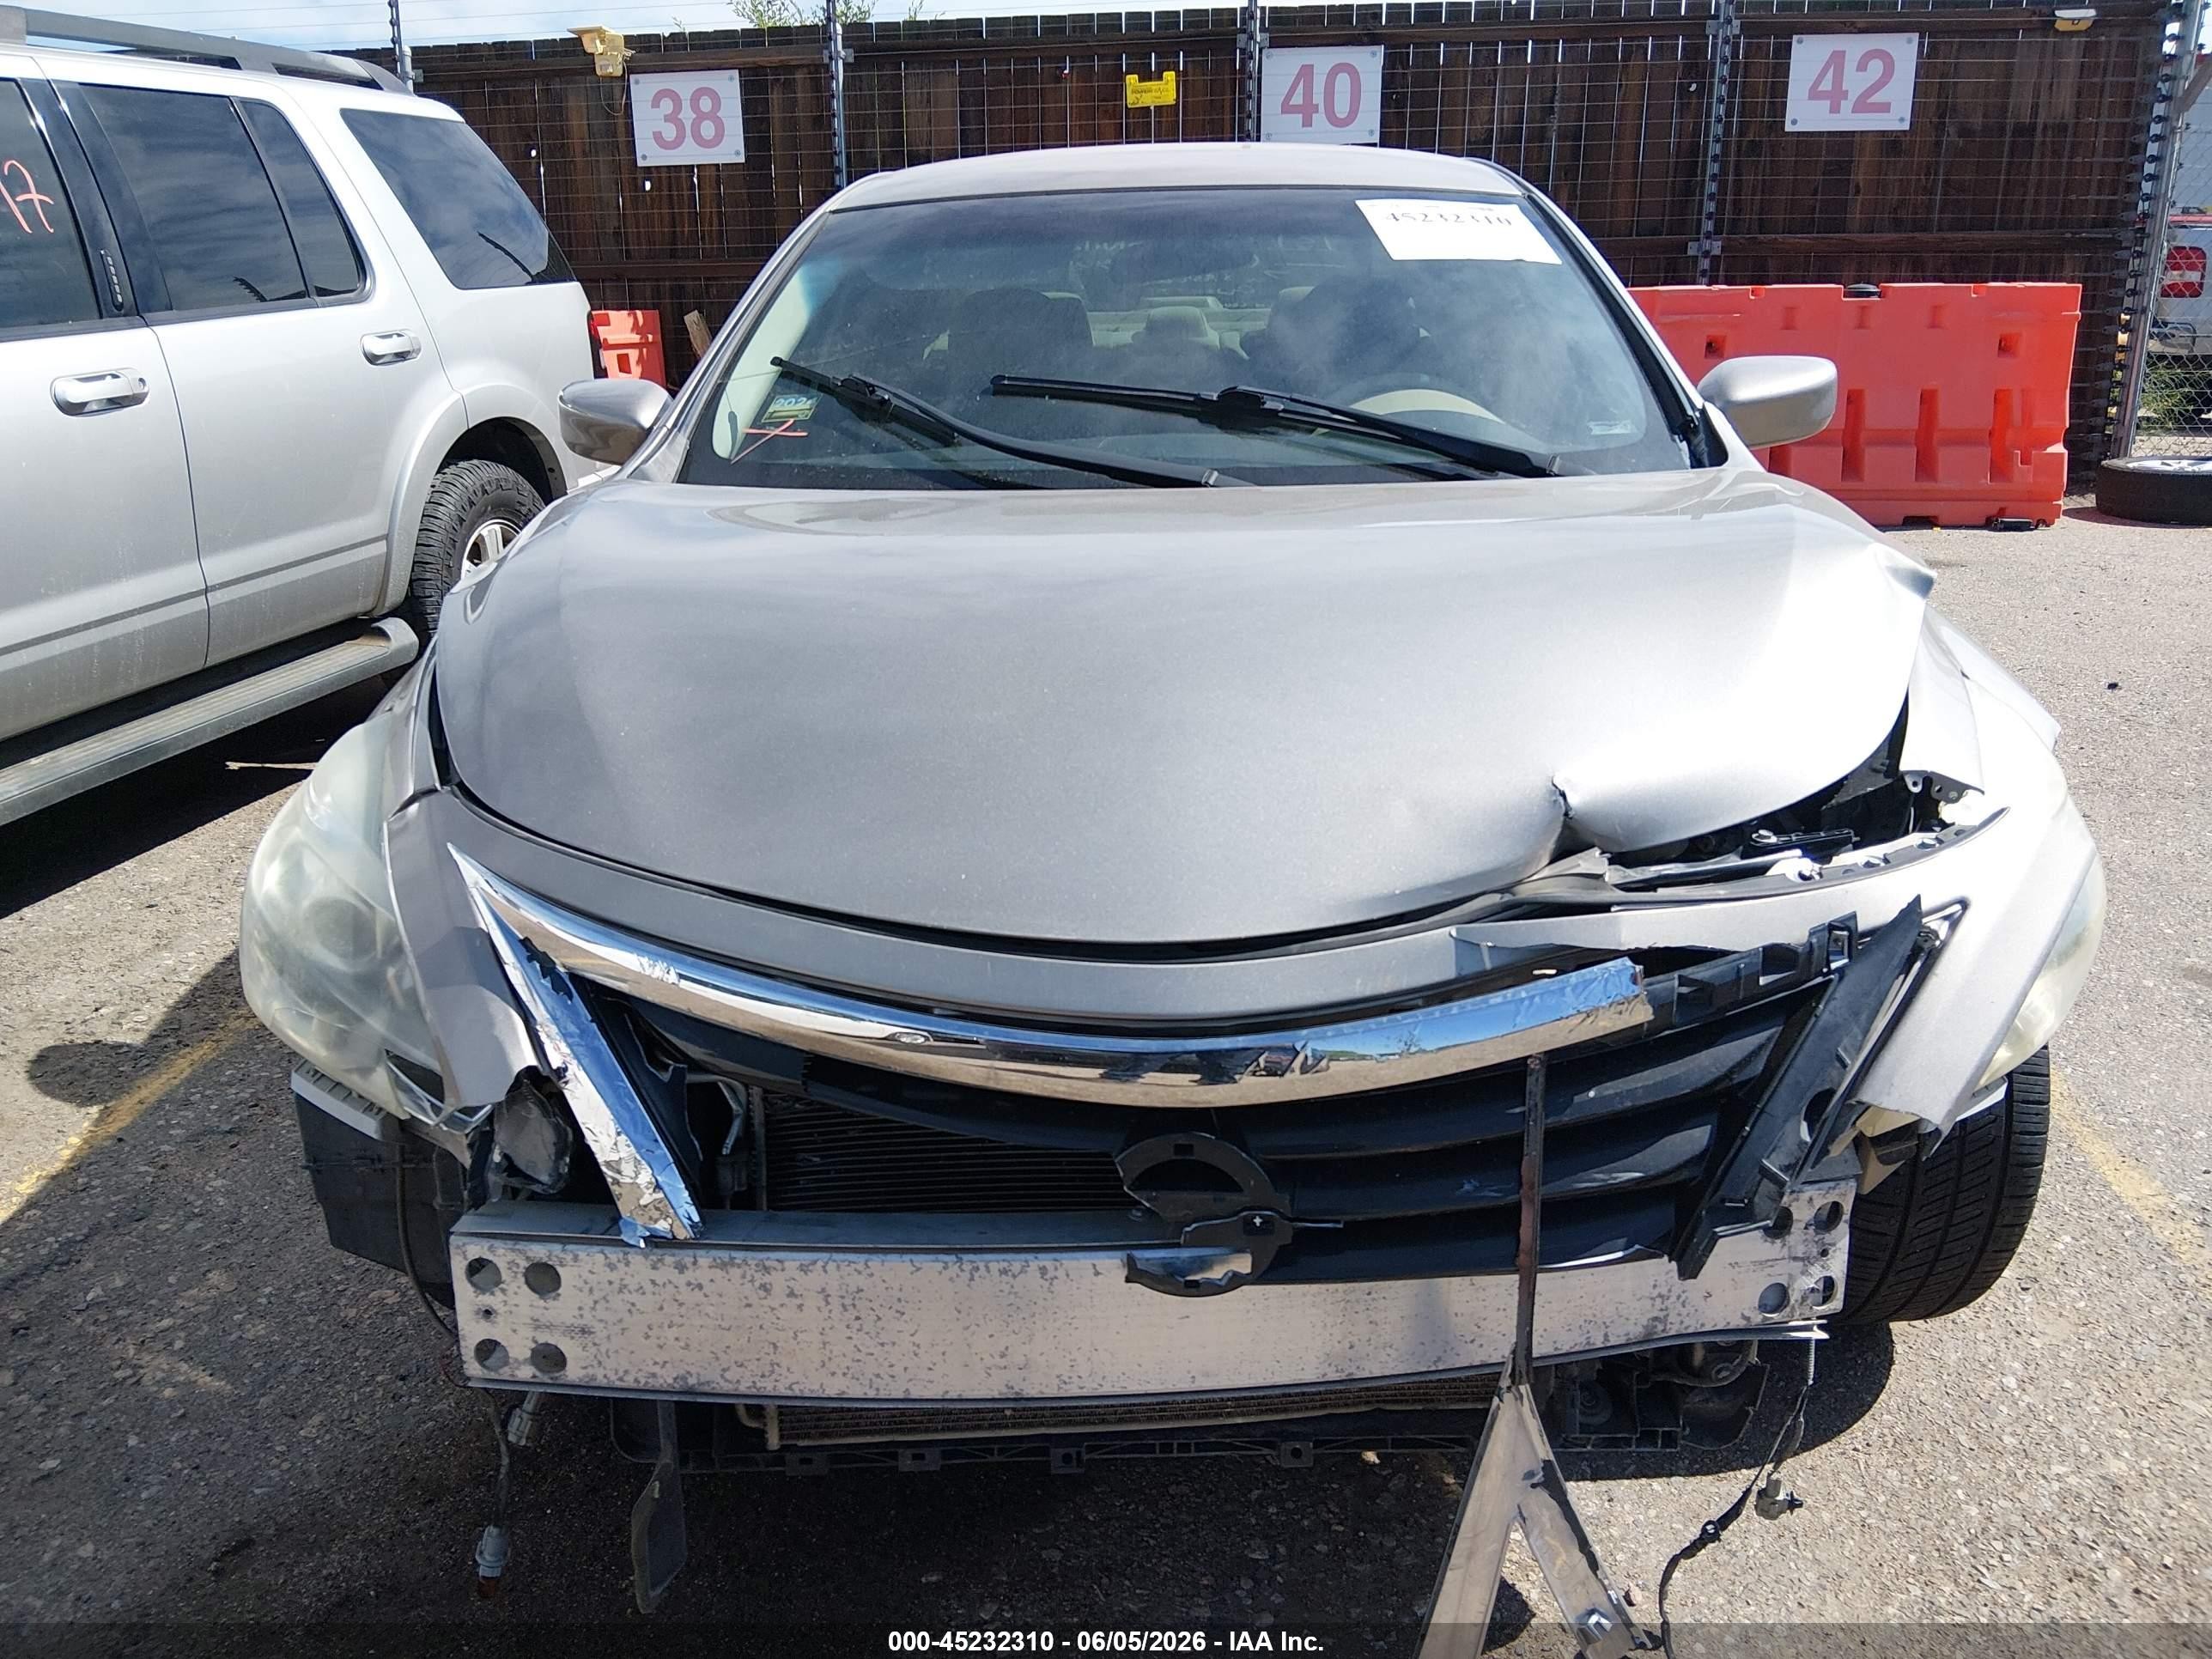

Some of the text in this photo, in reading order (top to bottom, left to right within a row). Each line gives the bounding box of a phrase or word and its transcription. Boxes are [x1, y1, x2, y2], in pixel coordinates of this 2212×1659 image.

[1280, 62, 1362, 128] 40
[1808, 48, 1895, 113] 42
[651, 87, 725, 150] 38
